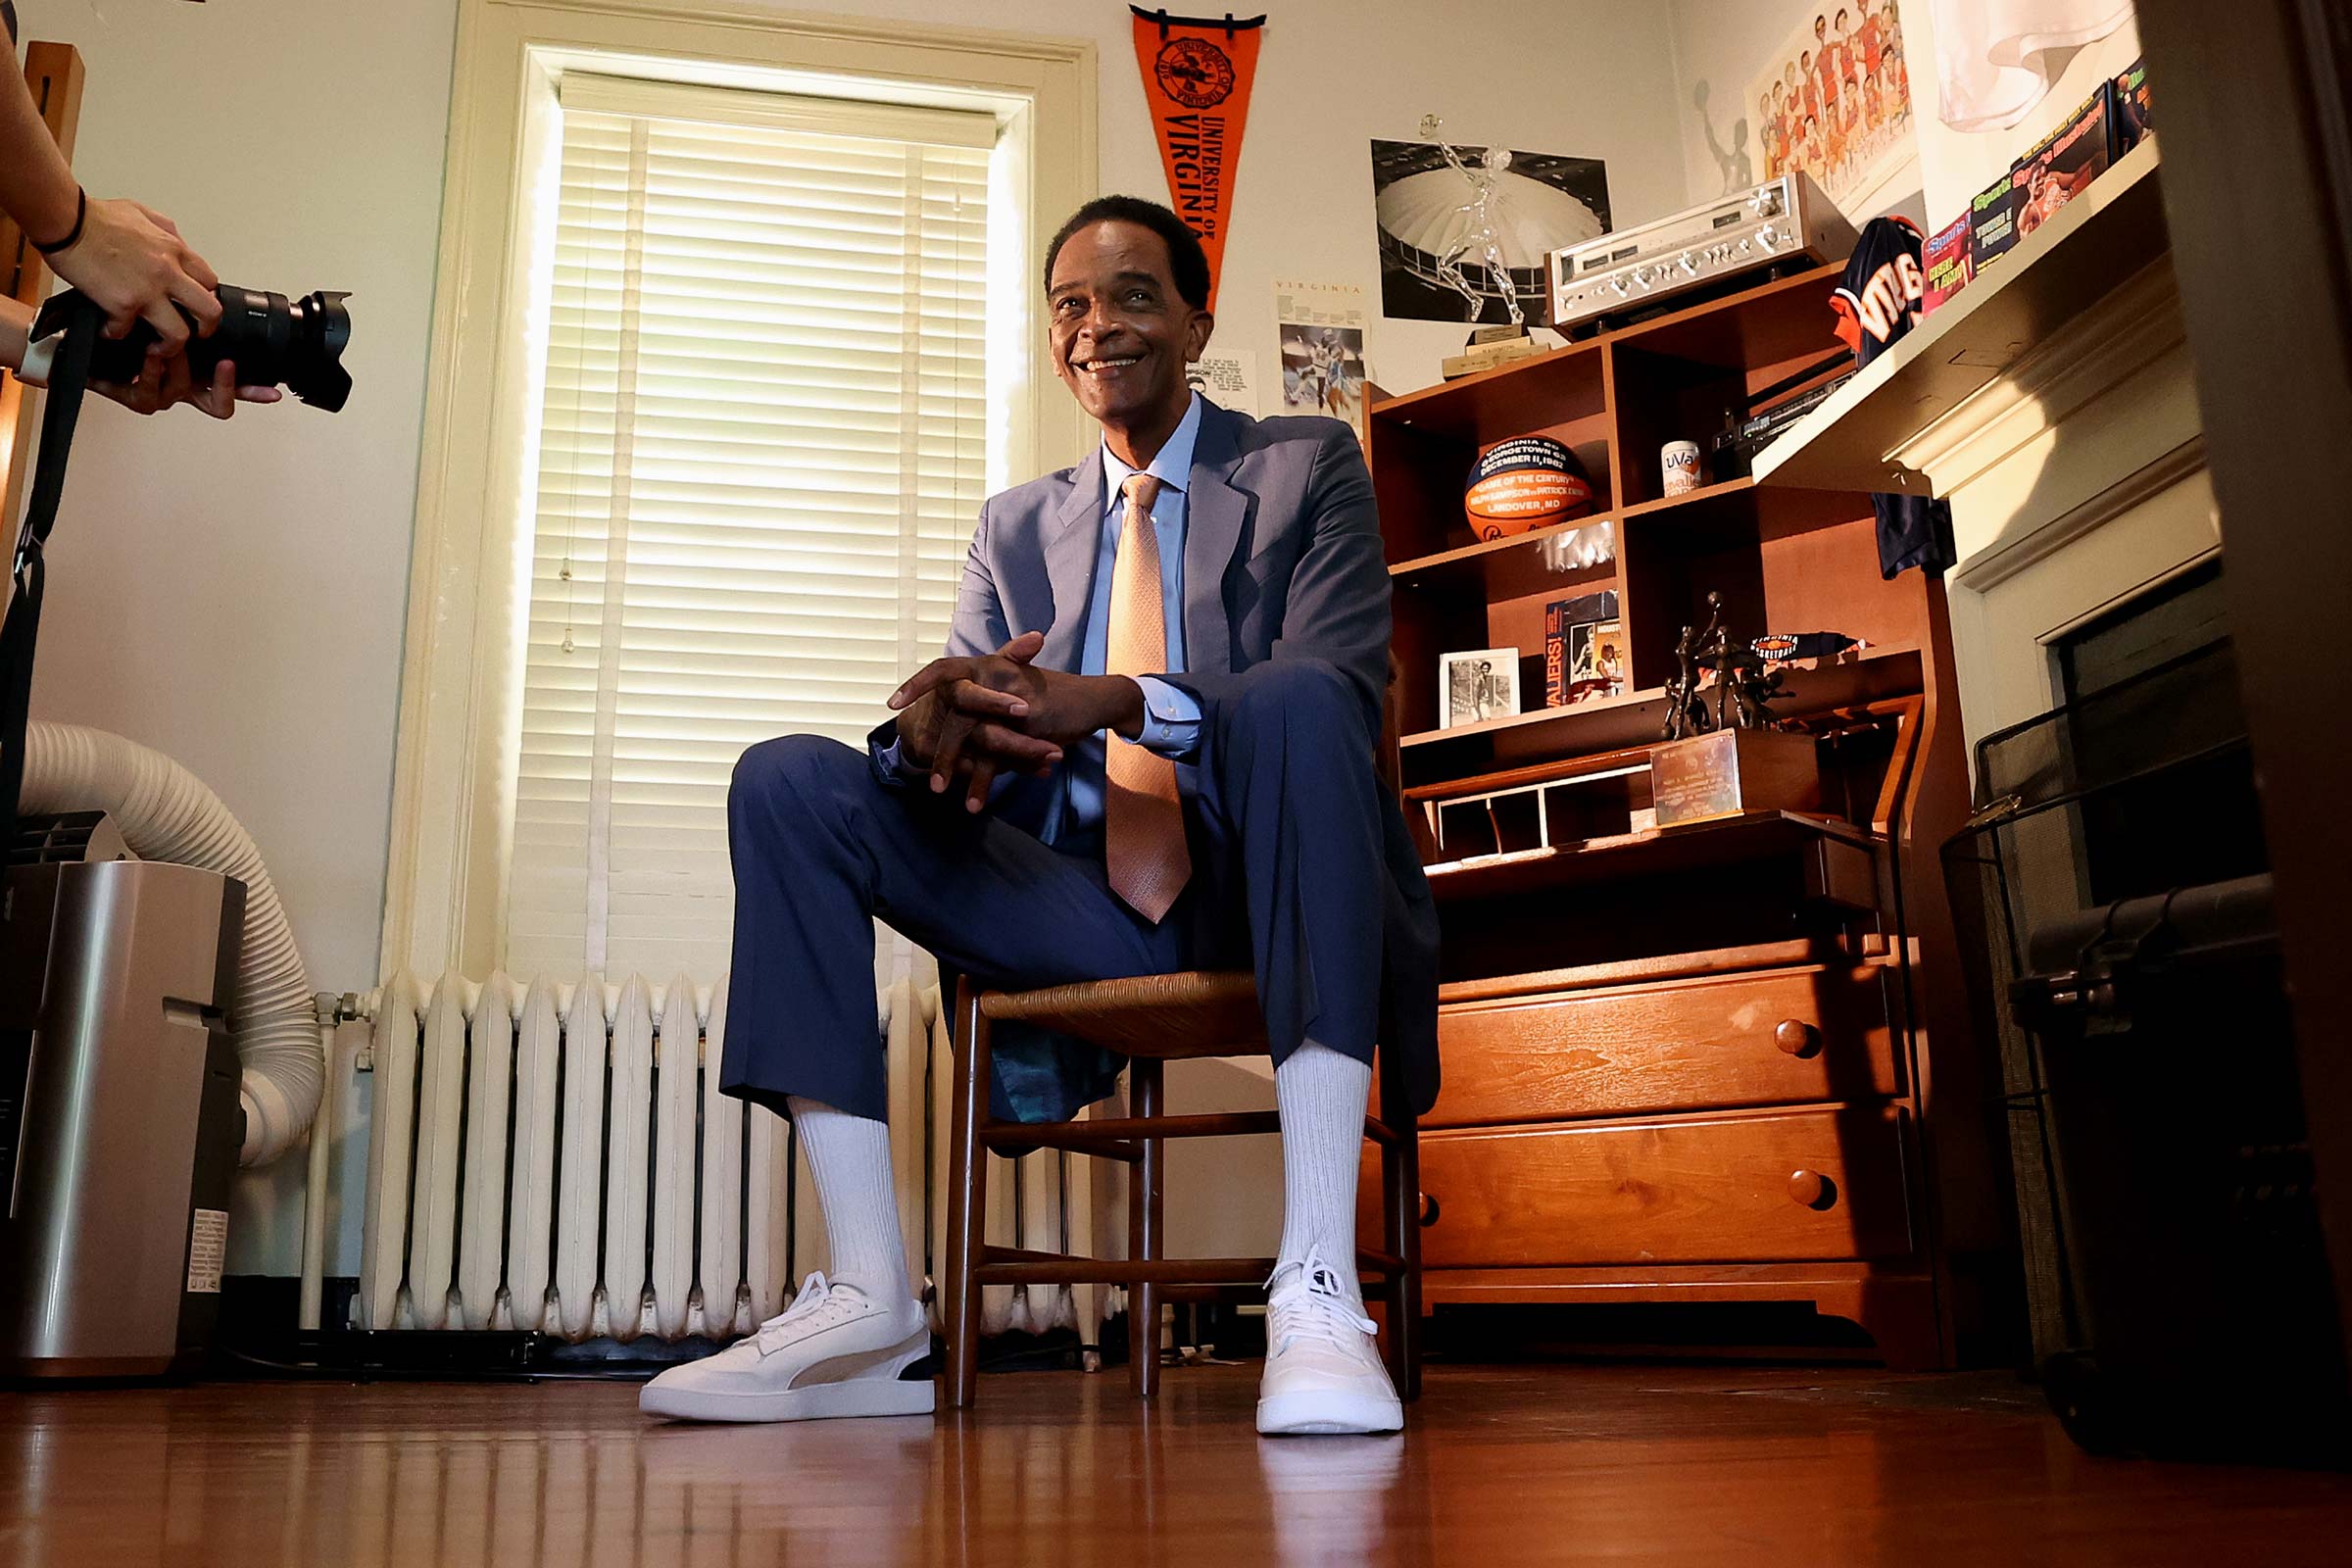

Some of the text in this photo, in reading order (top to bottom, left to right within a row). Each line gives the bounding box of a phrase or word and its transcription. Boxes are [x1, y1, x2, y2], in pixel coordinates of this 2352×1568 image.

[1201, 117, 1225, 240] UNIVERSITY OF
[1928, 220, 1966, 255] Sports
[1929, 256, 1954, 283] HERE
[1276, 281, 1360, 294] VIRGINIA
[1481, 445, 1551, 468] GEORGETOWN
[1486, 439, 1540, 458] VIRGINIA
[1480, 455, 1531, 477] DECEMBER
[1666, 452, 1693, 468] uVa
[1503, 475, 1516, 486] OF
[1517, 474, 1535, 484] THE
[1544, 500, 1561, 509] MD
